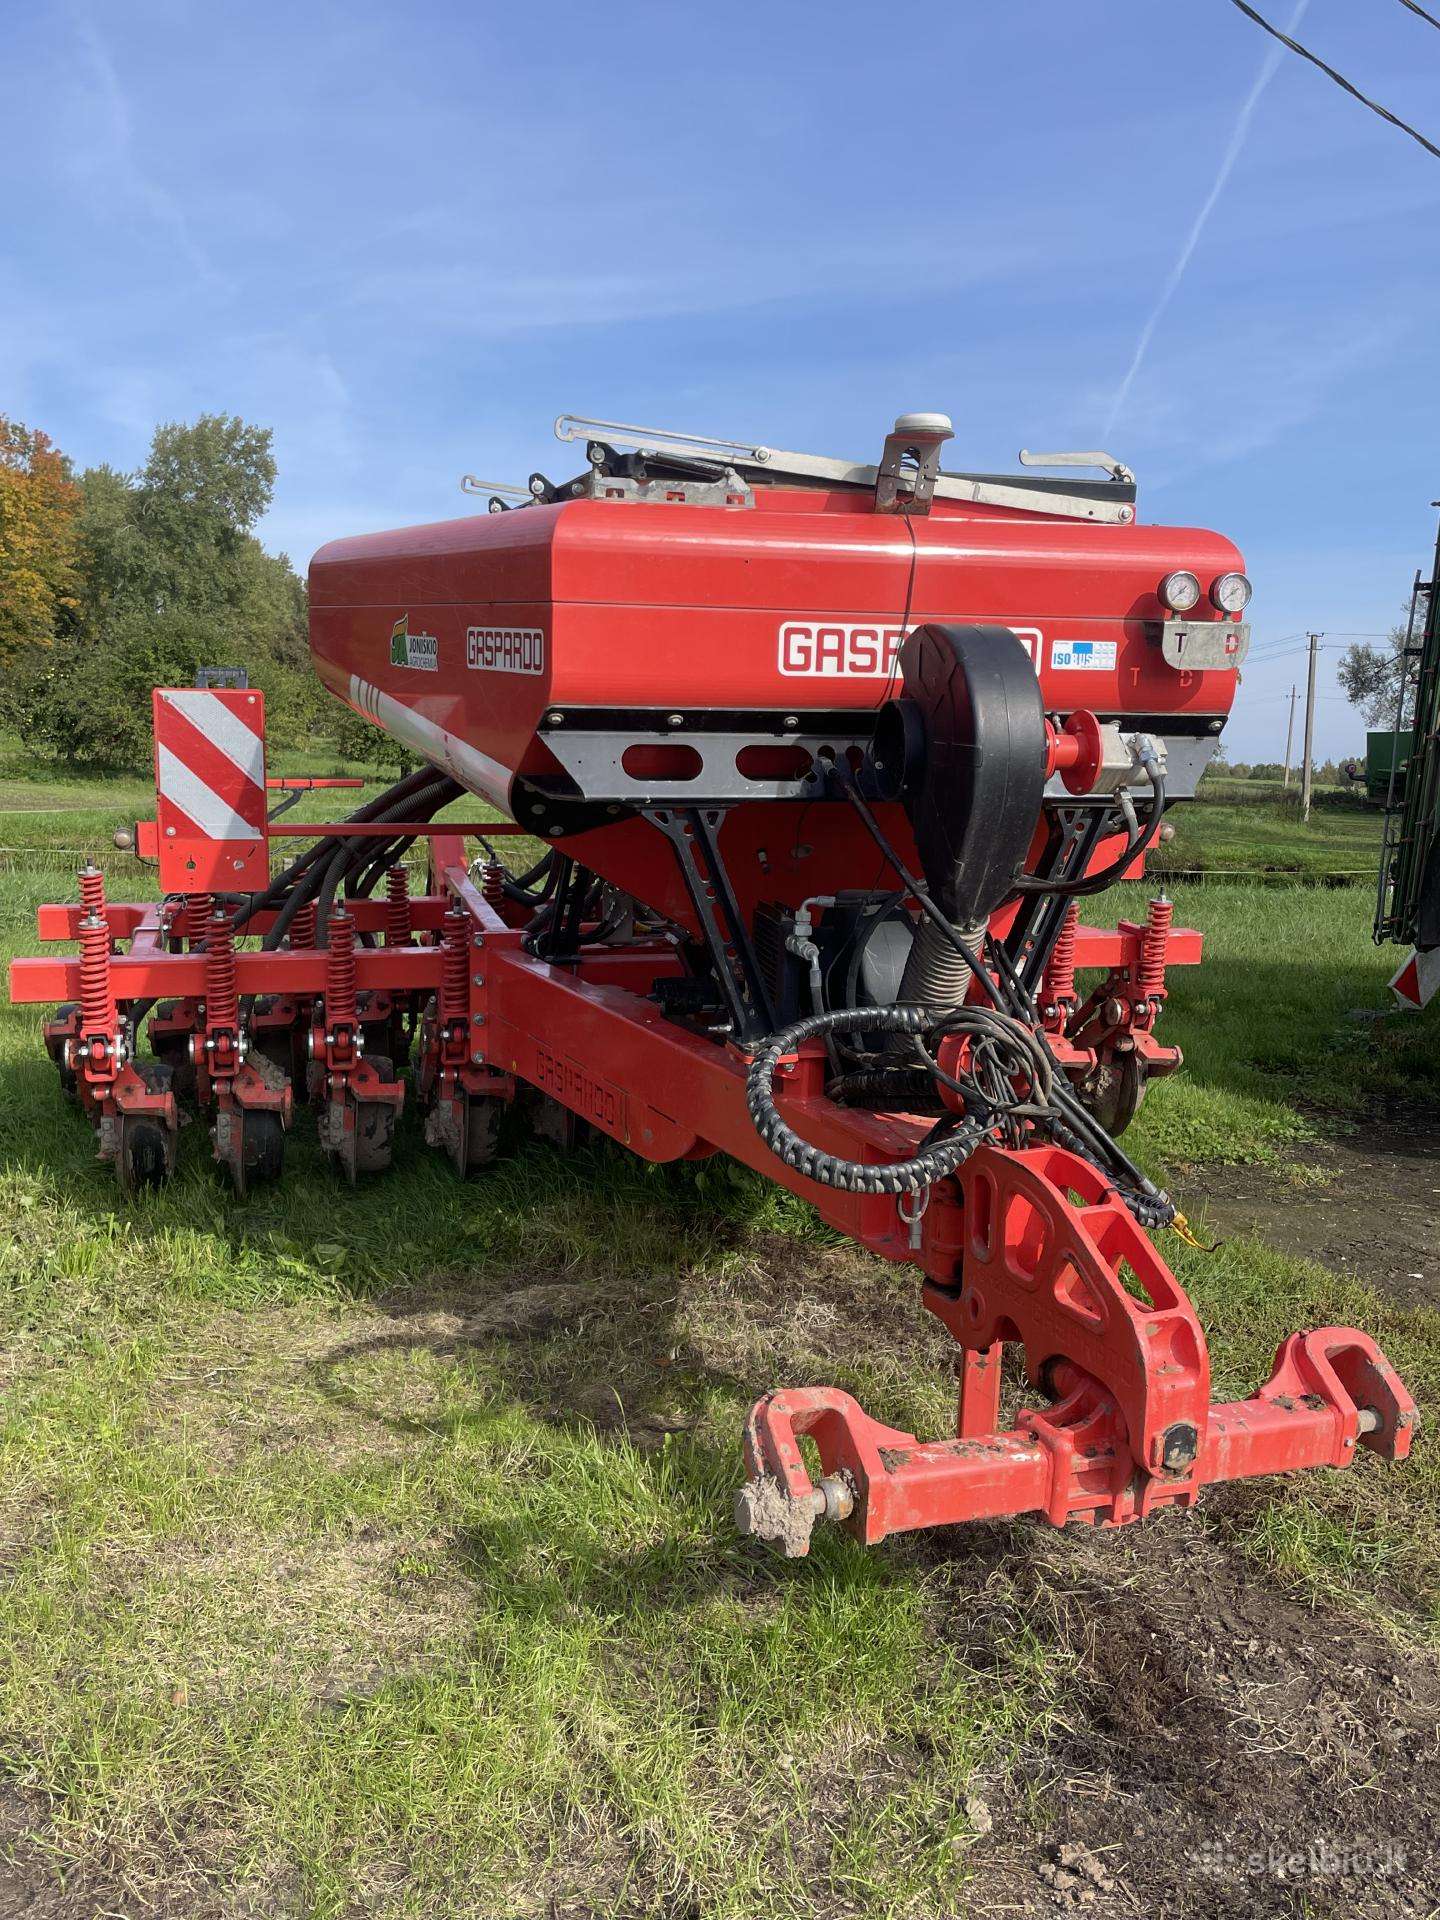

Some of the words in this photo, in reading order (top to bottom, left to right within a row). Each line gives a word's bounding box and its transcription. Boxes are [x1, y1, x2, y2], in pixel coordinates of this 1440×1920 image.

[468, 630, 542, 671] GASPARDO
[1175, 633, 1187, 653] T
[1225, 634, 1239, 654] D
